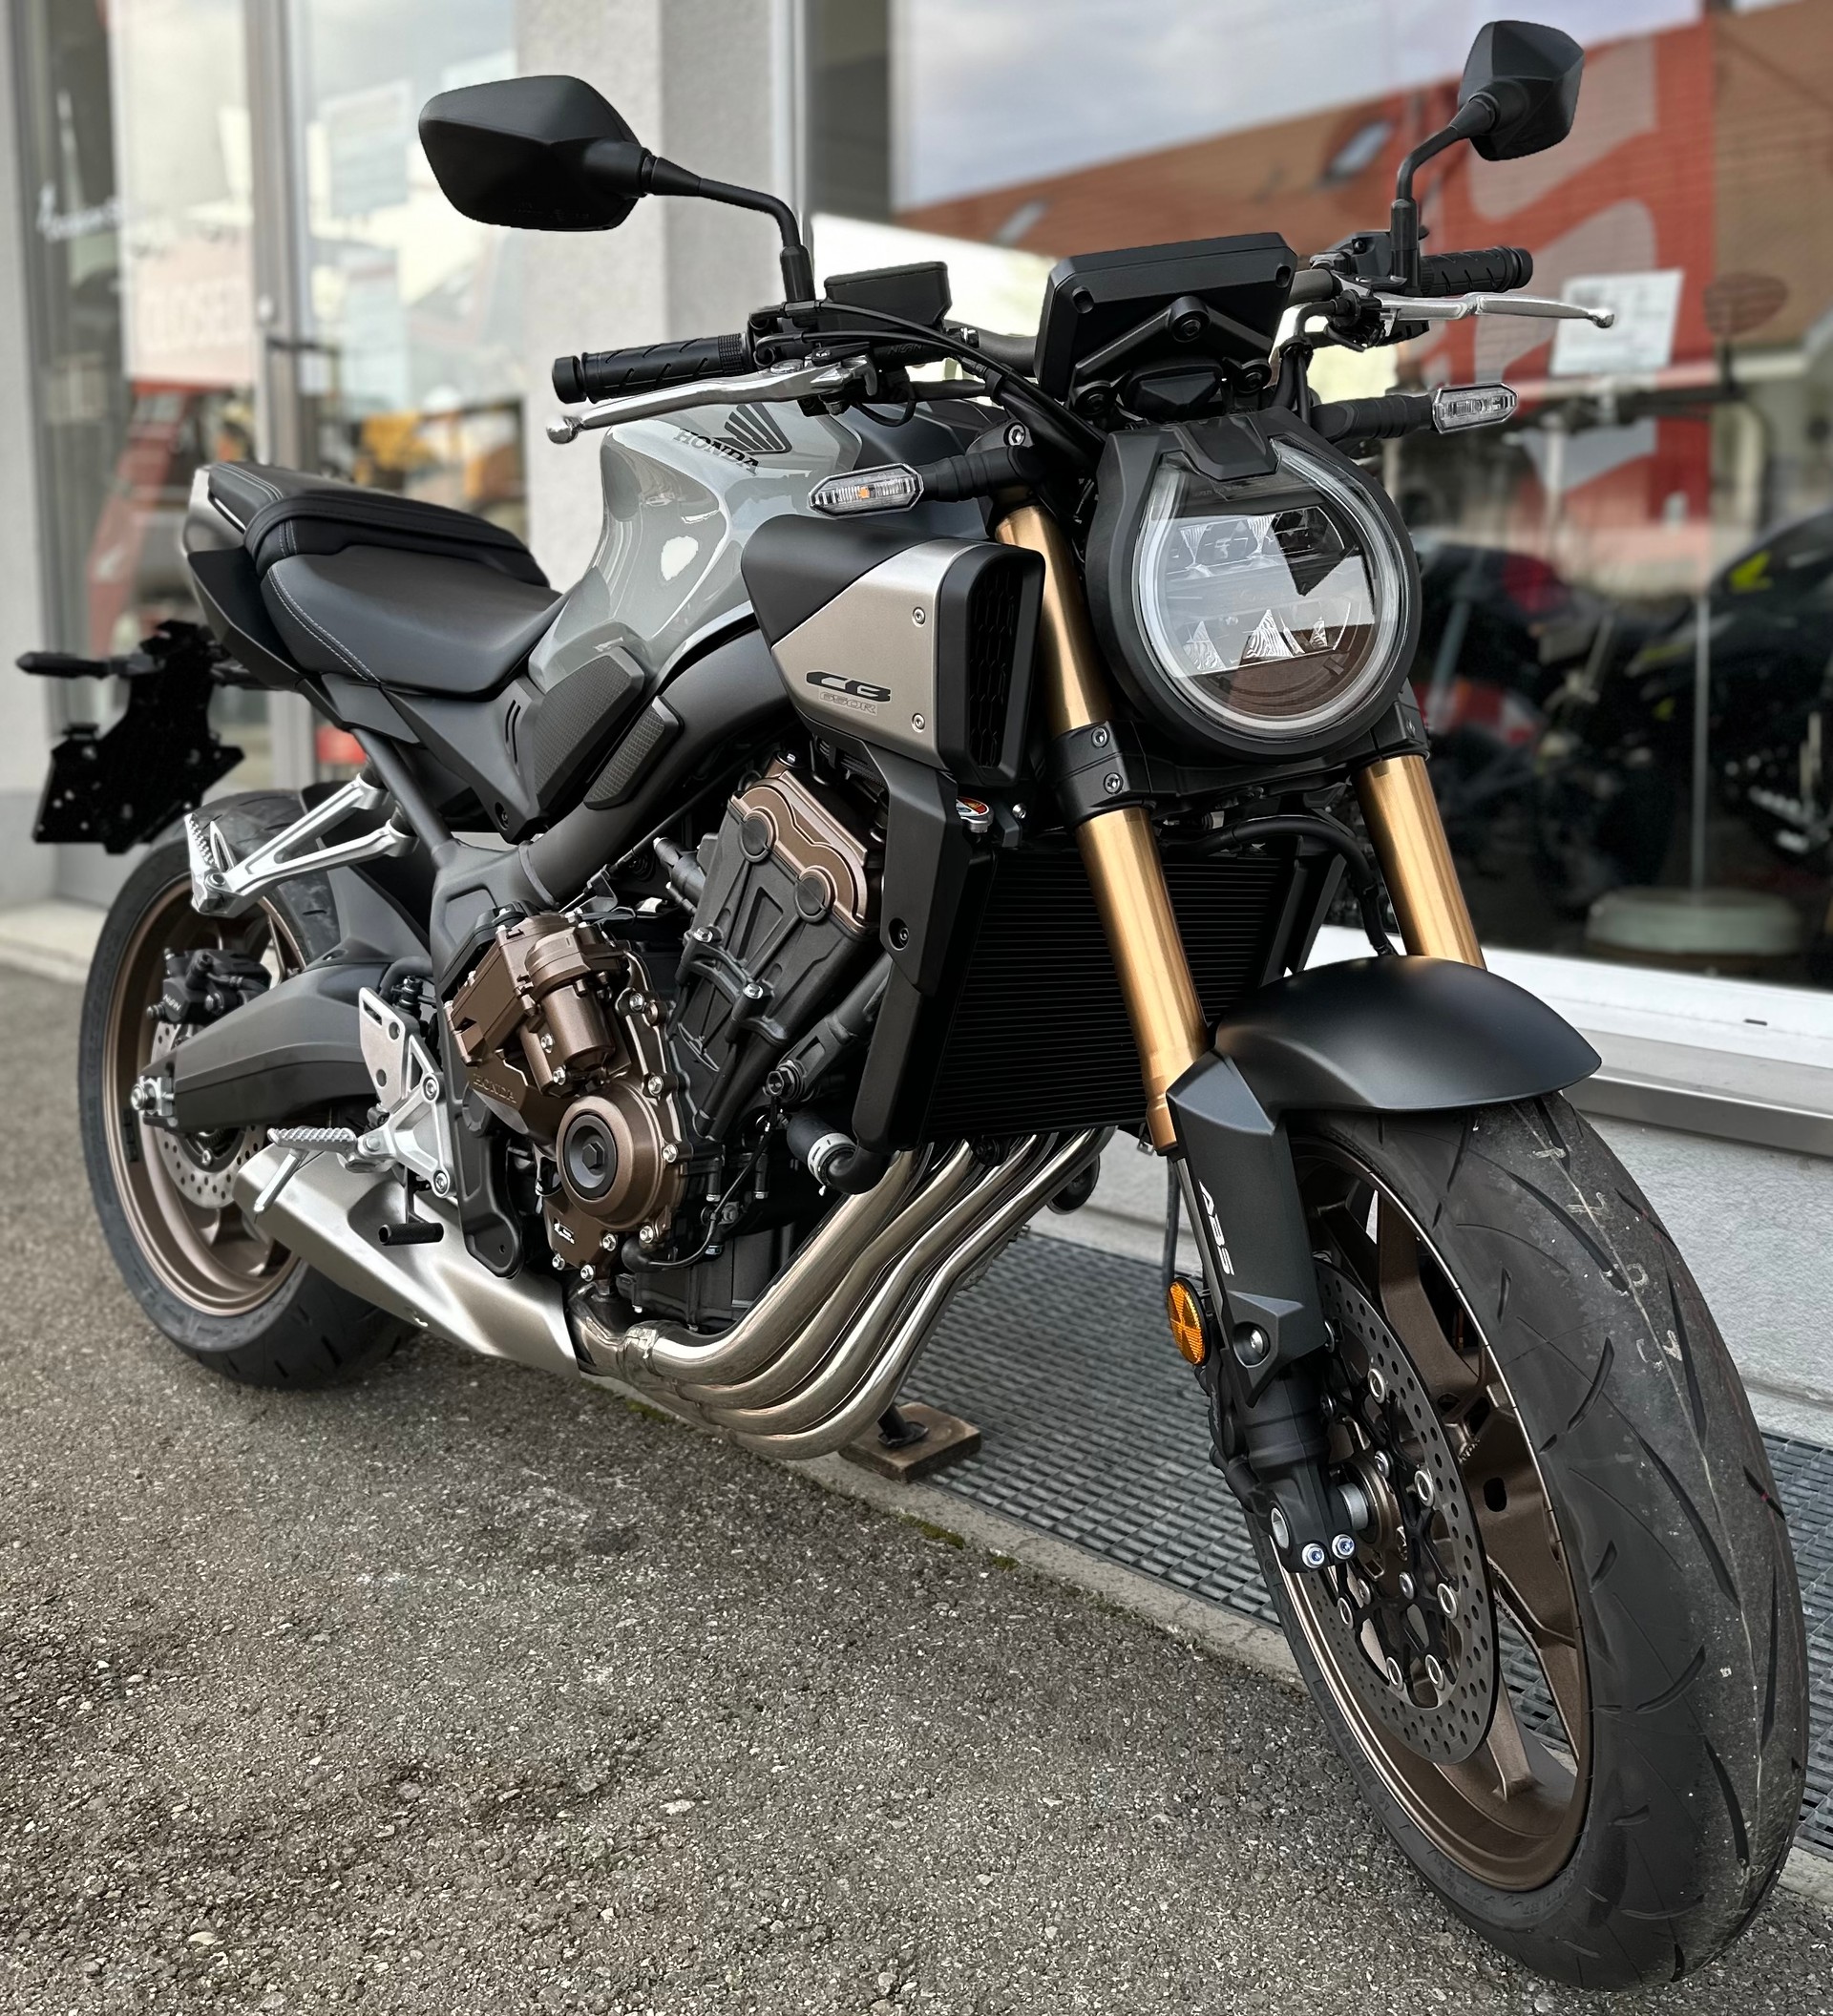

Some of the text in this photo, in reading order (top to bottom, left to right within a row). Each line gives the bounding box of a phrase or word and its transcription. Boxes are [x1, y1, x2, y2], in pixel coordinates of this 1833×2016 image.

[673, 428, 759, 476] HONDA
[806, 671, 892, 703] CB
[820, 691, 877, 716] 650R
[473, 1073, 517, 1103] HONDA
[1198, 1179, 1234, 1275] ABS
